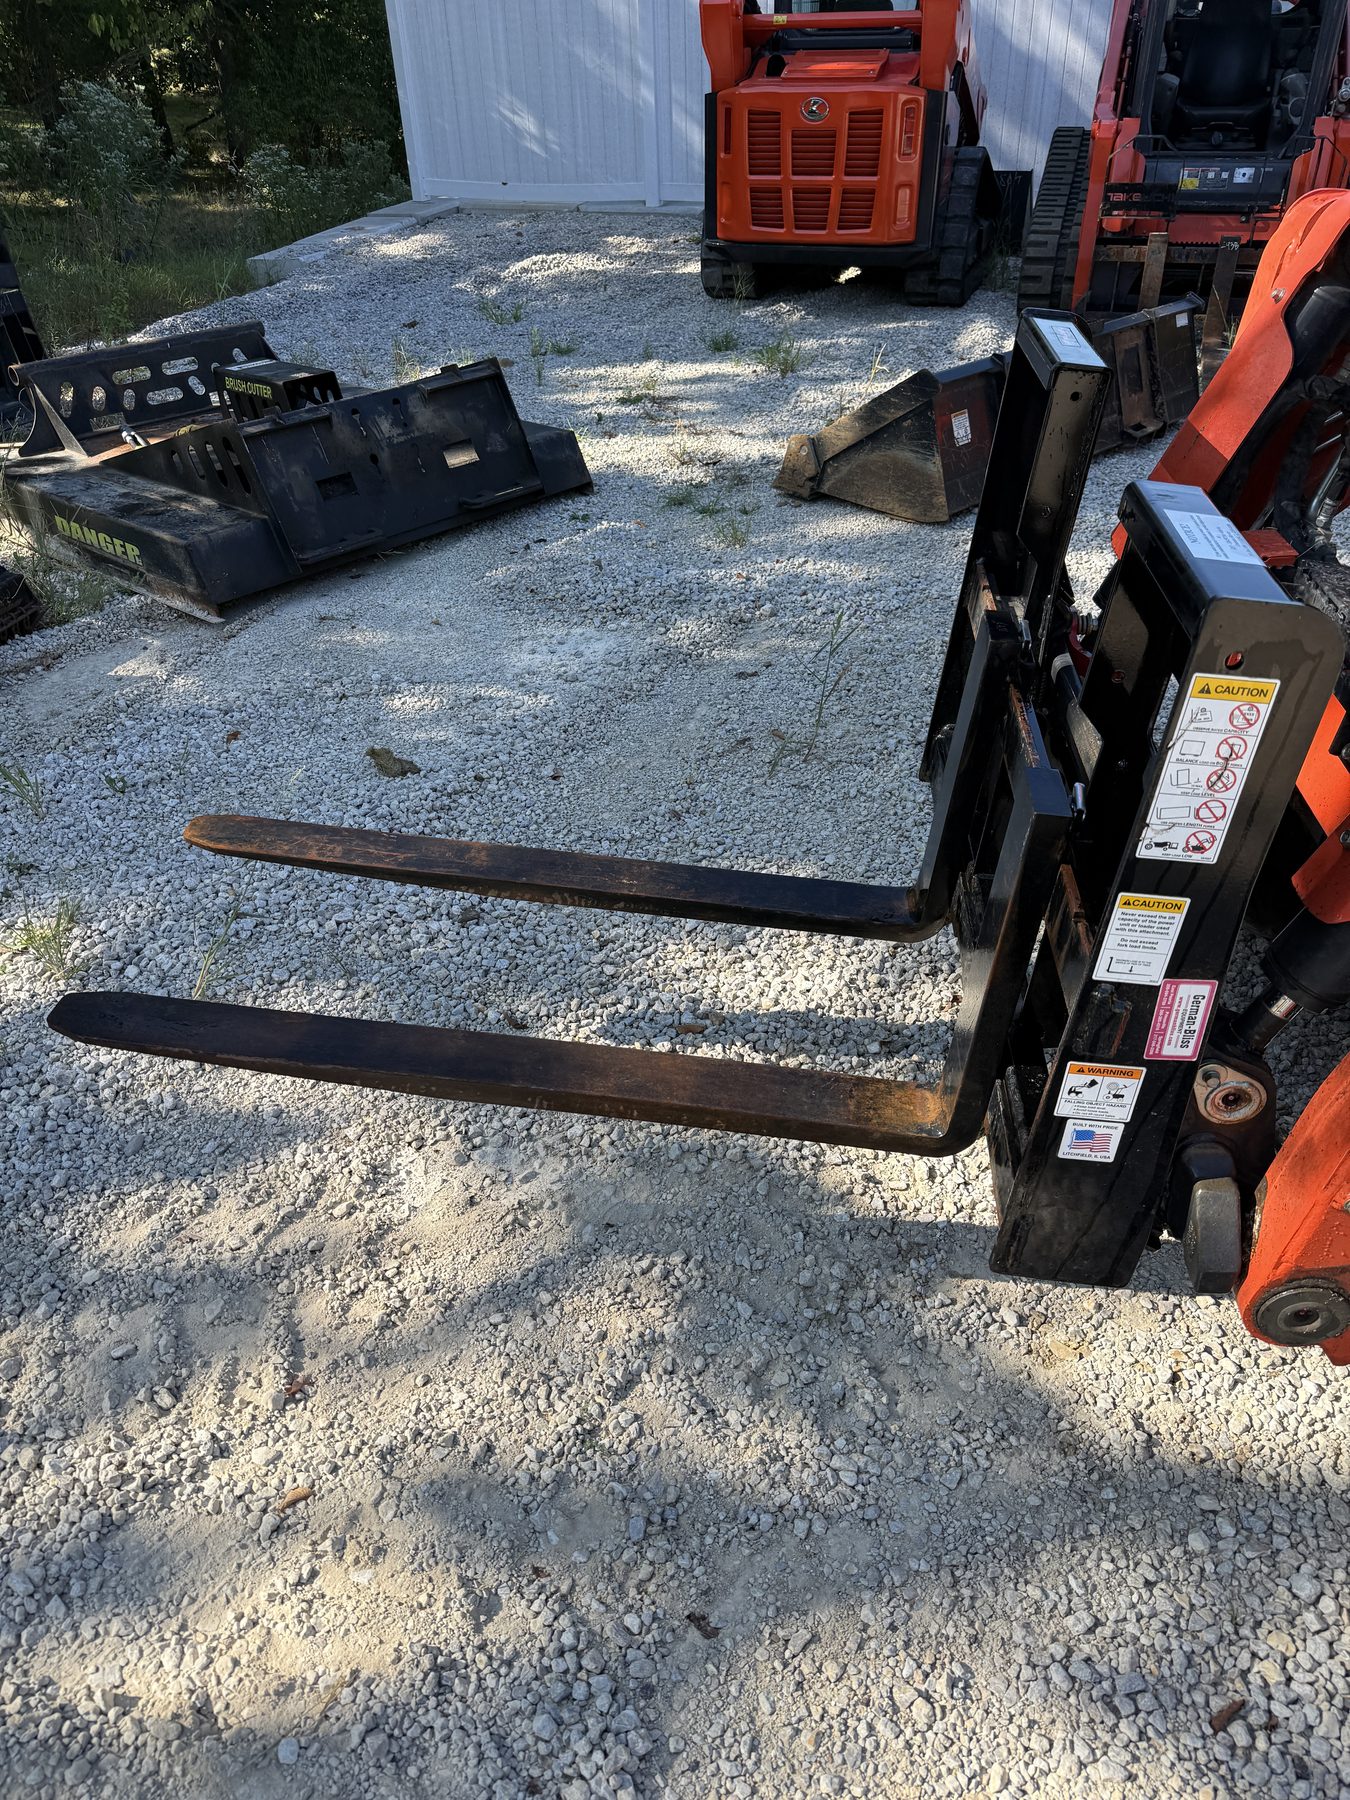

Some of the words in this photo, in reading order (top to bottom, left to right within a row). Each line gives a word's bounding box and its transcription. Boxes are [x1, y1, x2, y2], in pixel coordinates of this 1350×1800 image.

[225, 377, 246, 392] BRUSH
[247, 382, 272, 399] CUTTER
[55, 515, 143, 566] DANGER
[1215, 685, 1269, 698] CAUTION
[1132, 900, 1183, 911] CAUTION
[1139, 928, 1170, 936] attachment.
[1177, 1009, 1188, 1034] EQUIPMENT
[1180, 995, 1205, 1048] German-Bliss
[1088, 1067, 1134, 1077] WARNING
